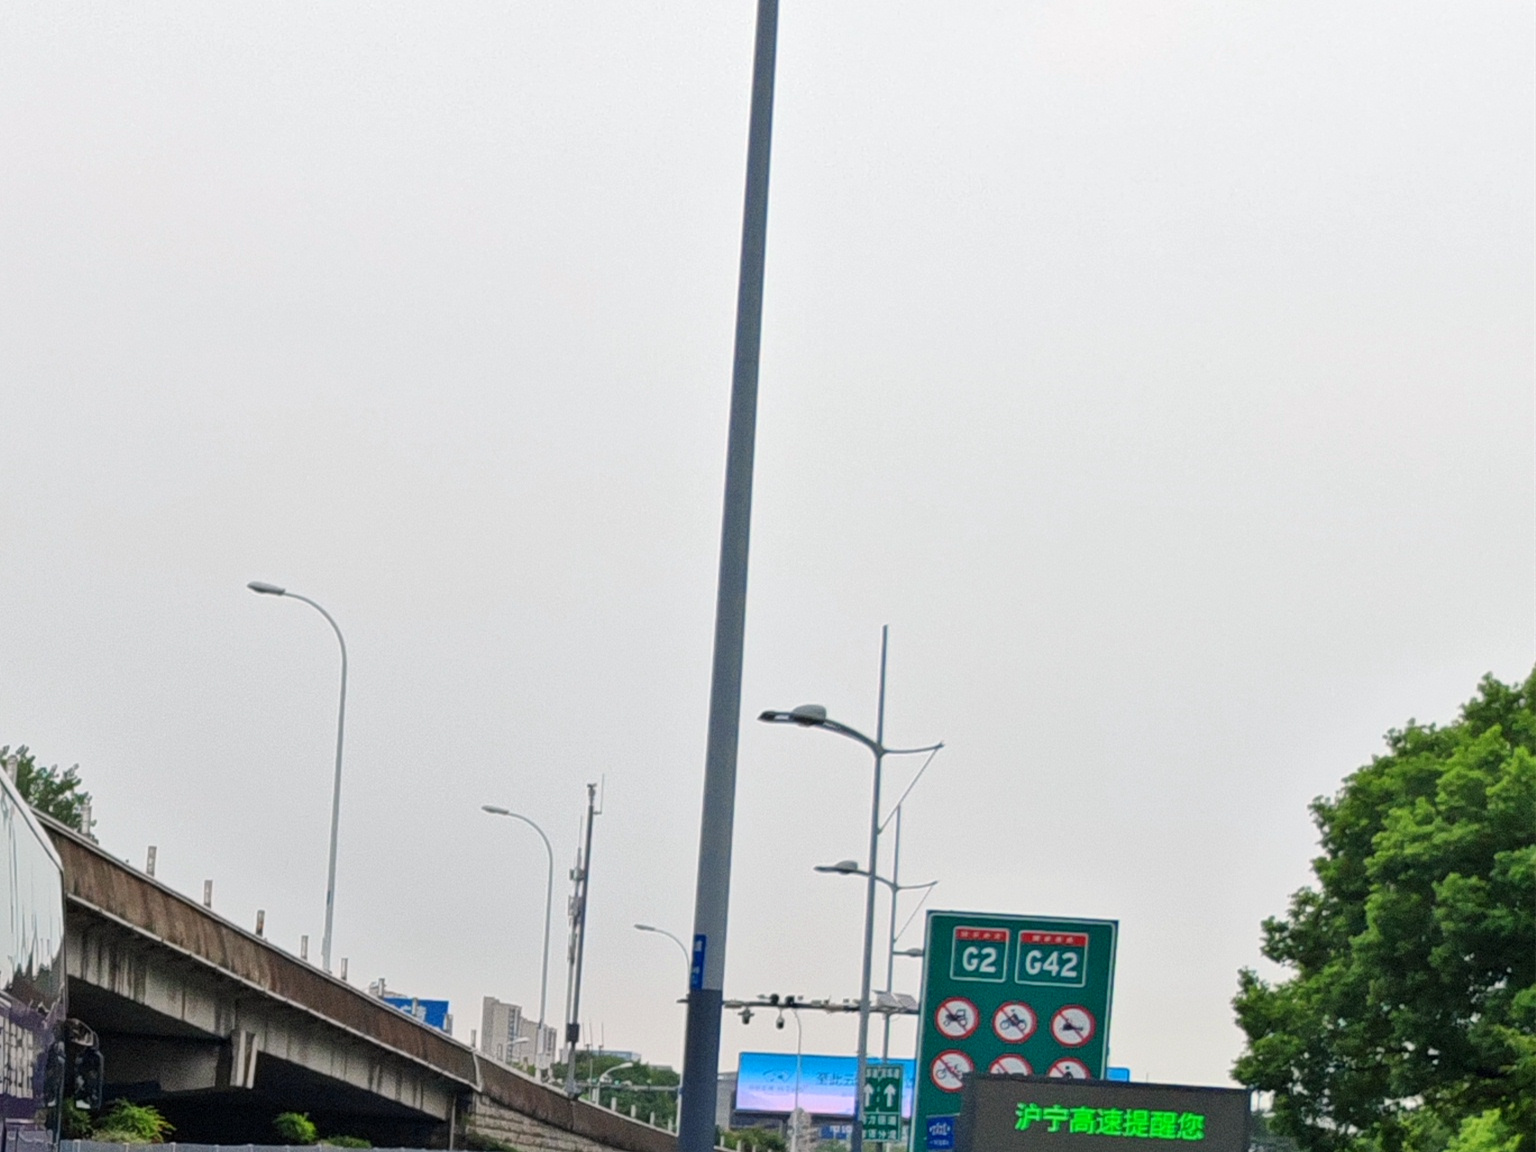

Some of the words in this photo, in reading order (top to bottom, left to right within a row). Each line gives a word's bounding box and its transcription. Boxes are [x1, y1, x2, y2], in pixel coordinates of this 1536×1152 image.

[962, 946, 997, 973] G2
[1025, 950, 1078, 978] G42
[1015, 1102, 1205, 1141] 沪宁高速提醒您
